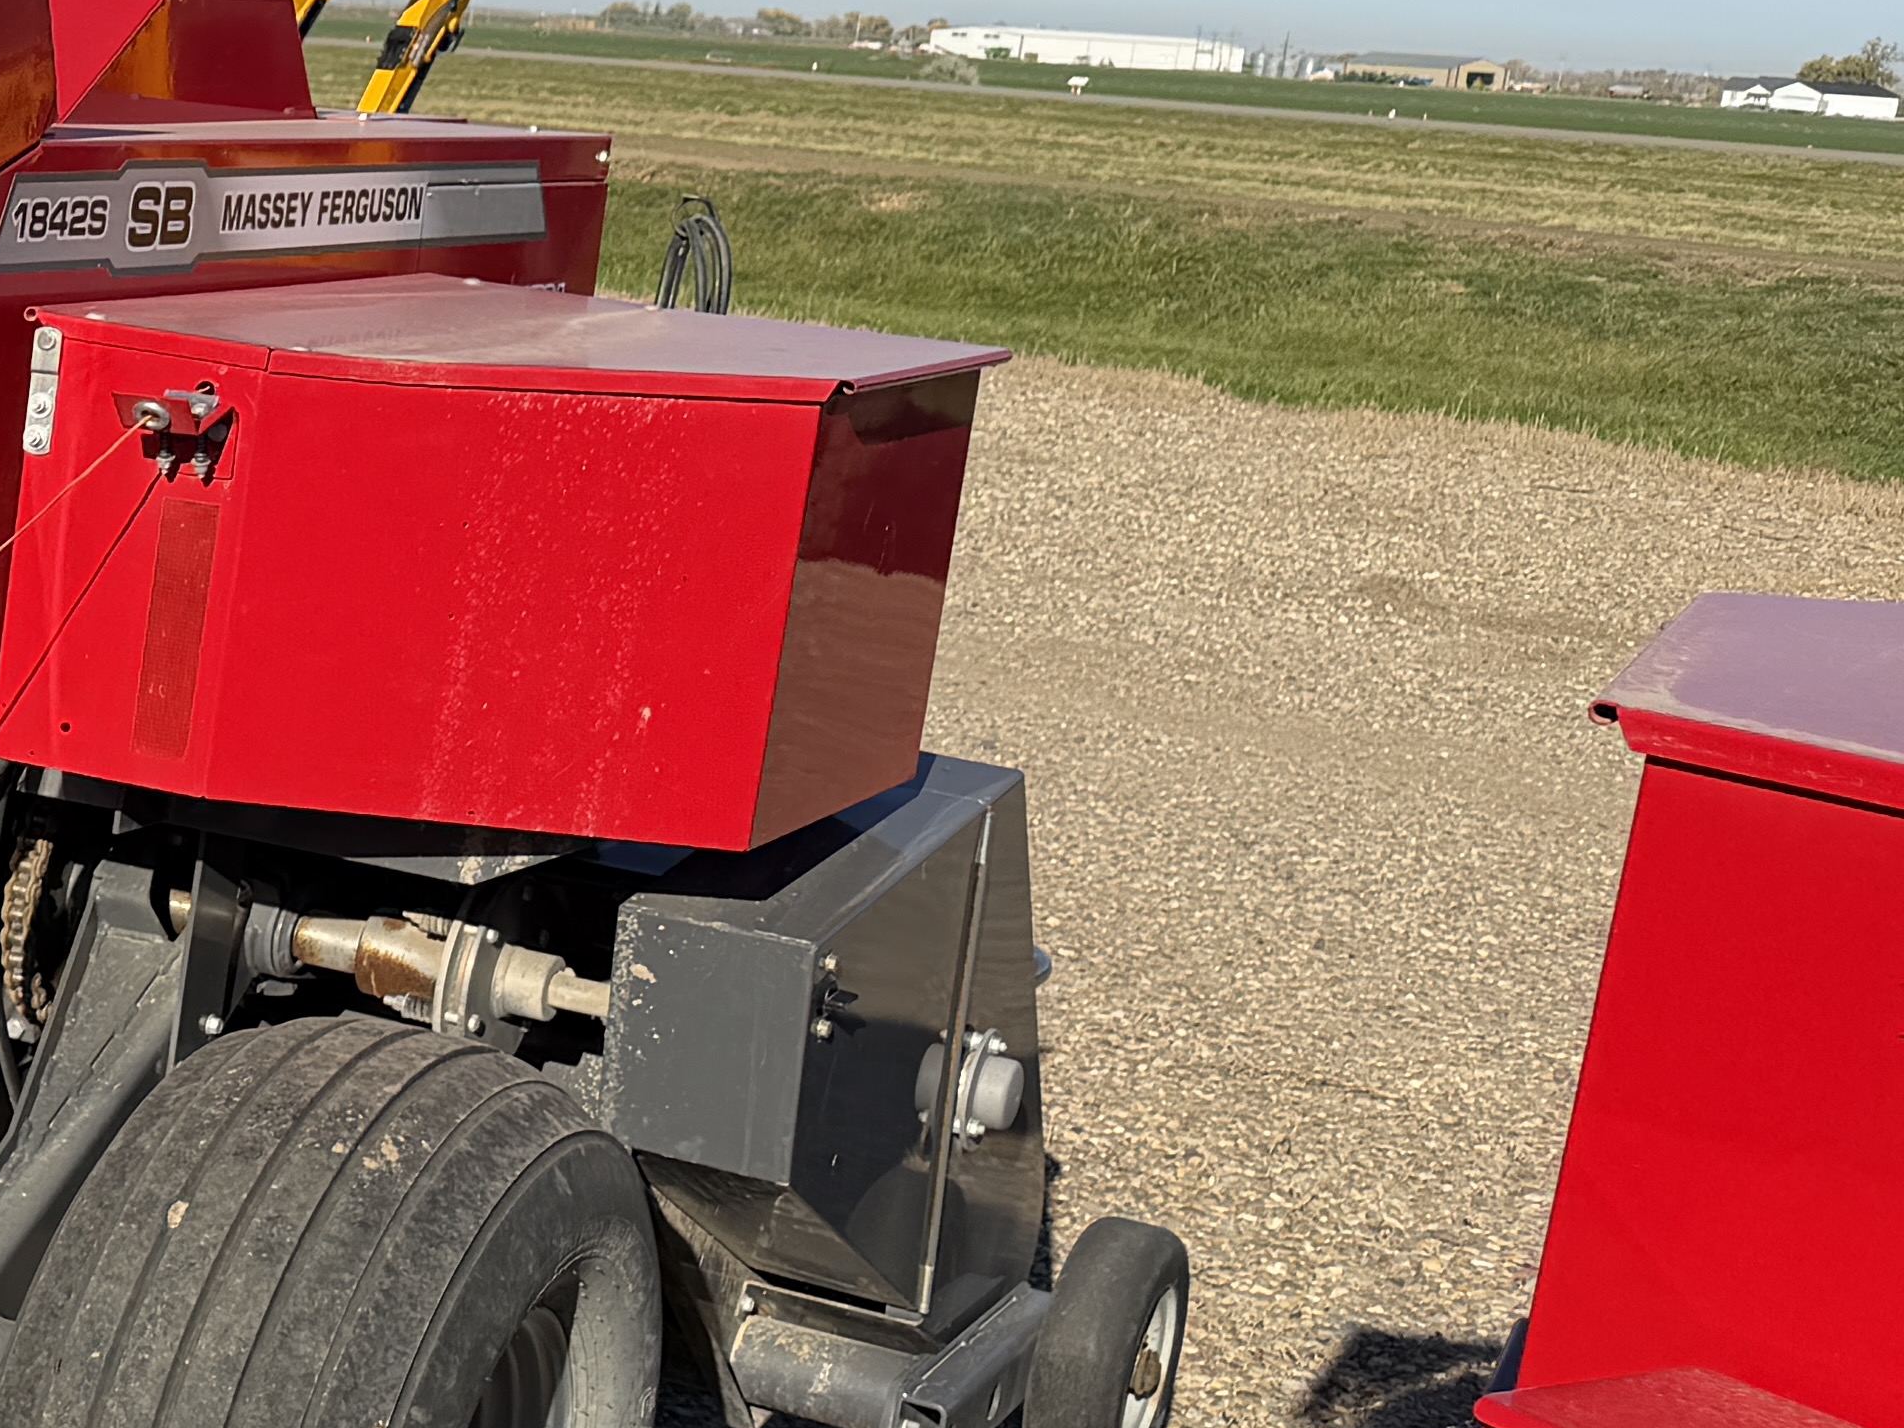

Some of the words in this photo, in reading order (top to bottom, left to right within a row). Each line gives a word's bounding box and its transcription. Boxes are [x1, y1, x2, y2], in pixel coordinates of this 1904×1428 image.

[12, 196, 110, 242] 1842S
[126, 180, 196, 253] SB
[219, 190, 313, 233] MASSEY
[316, 185, 424, 227] FERGUSON
